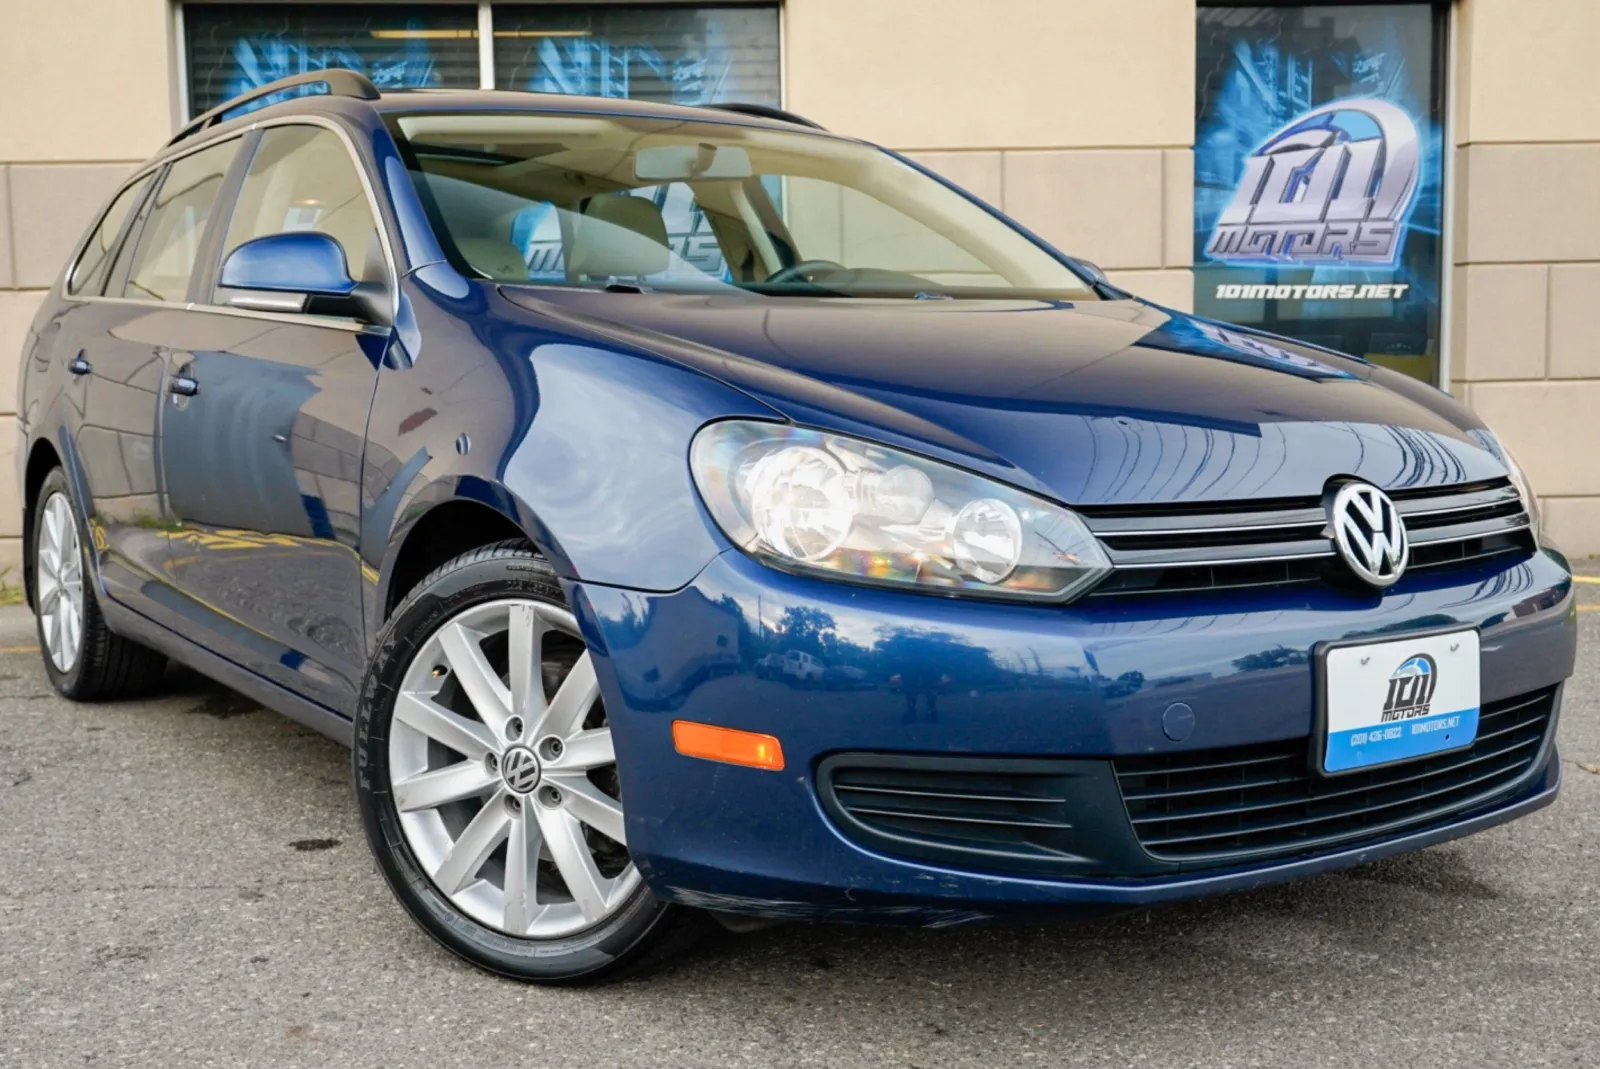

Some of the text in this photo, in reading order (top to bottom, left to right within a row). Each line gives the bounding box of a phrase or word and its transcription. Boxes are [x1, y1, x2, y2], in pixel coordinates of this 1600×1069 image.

[1207, 222, 1399, 260] MOTORS
[1215, 283, 1408, 299] 101MOTORS.NET
[1383, 670, 1431, 710] 101
[1380, 703, 1430, 722] MOTORS
